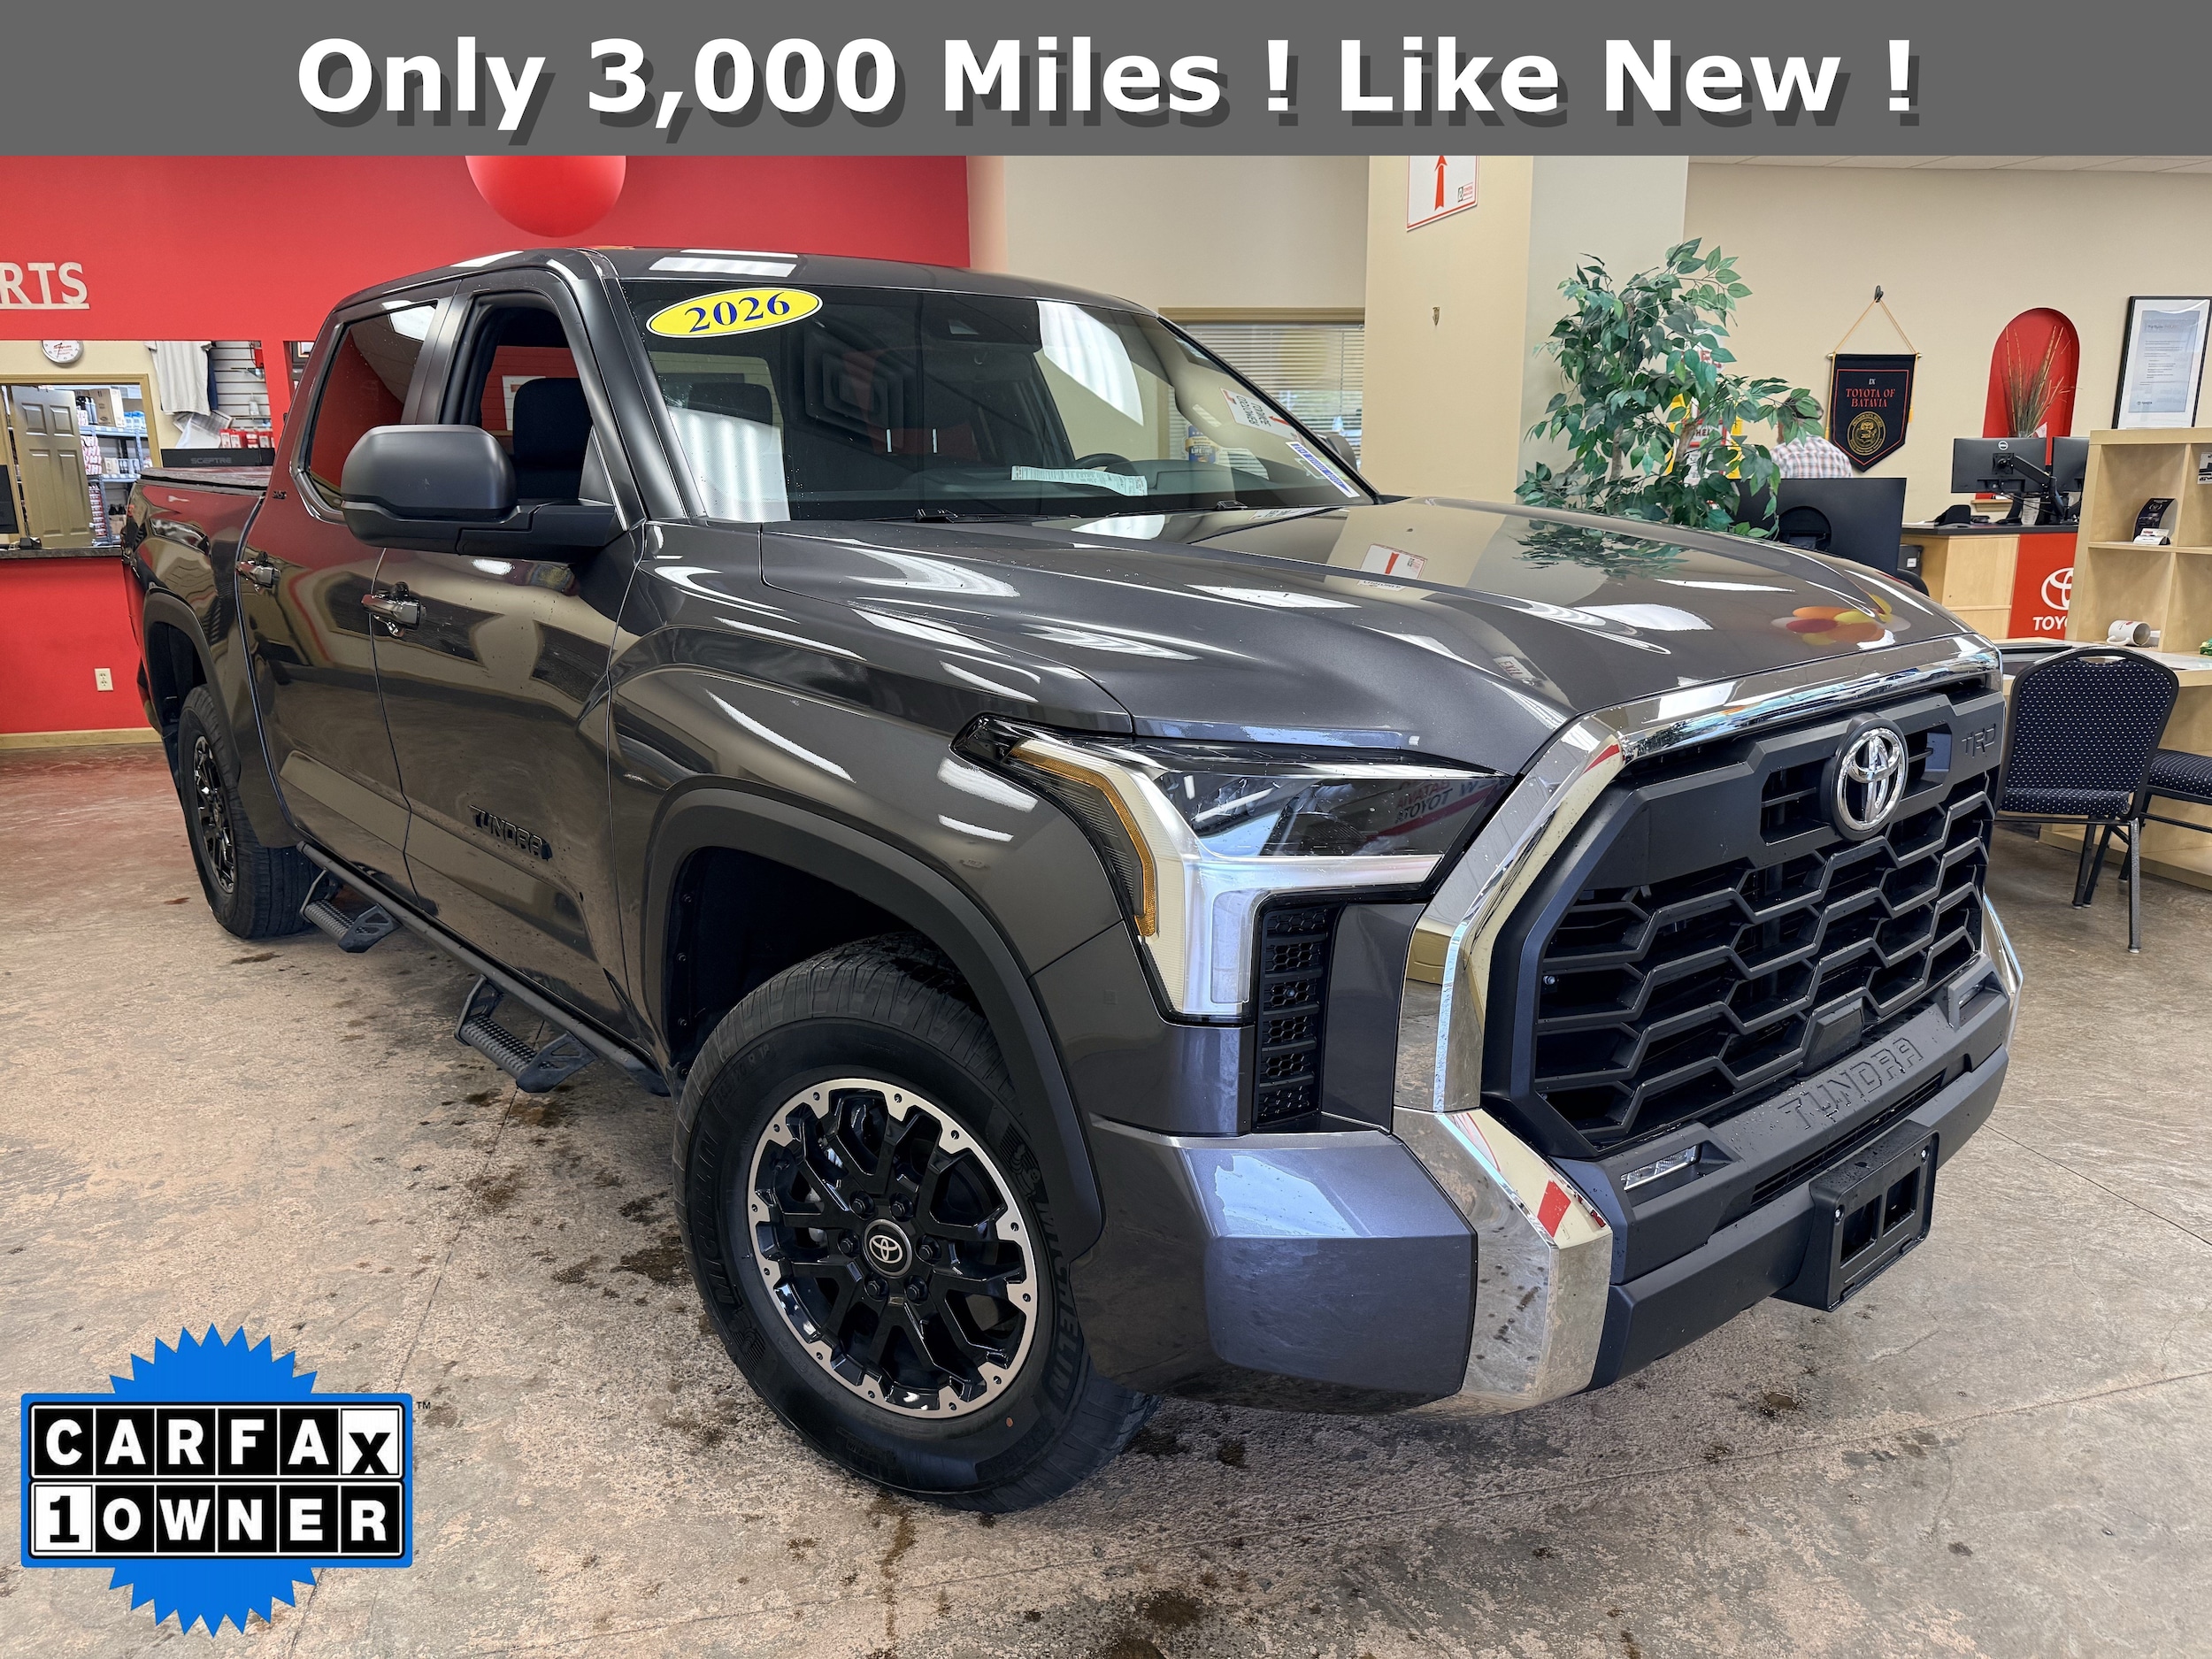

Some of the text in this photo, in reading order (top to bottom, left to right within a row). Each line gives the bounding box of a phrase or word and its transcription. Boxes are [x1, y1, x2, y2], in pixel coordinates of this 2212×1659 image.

[684, 292, 791, 333] 2026
[1846, 388, 1896, 398] TOYOTA OF
[1851, 398, 1888, 408] BATAVIA
[190, 457, 233, 465] SCEPTRE
[1961, 723, 1996, 758] TRD
[467, 804, 553, 862] TUNDRA
[1777, 1037, 1924, 1130] TUNDRA
